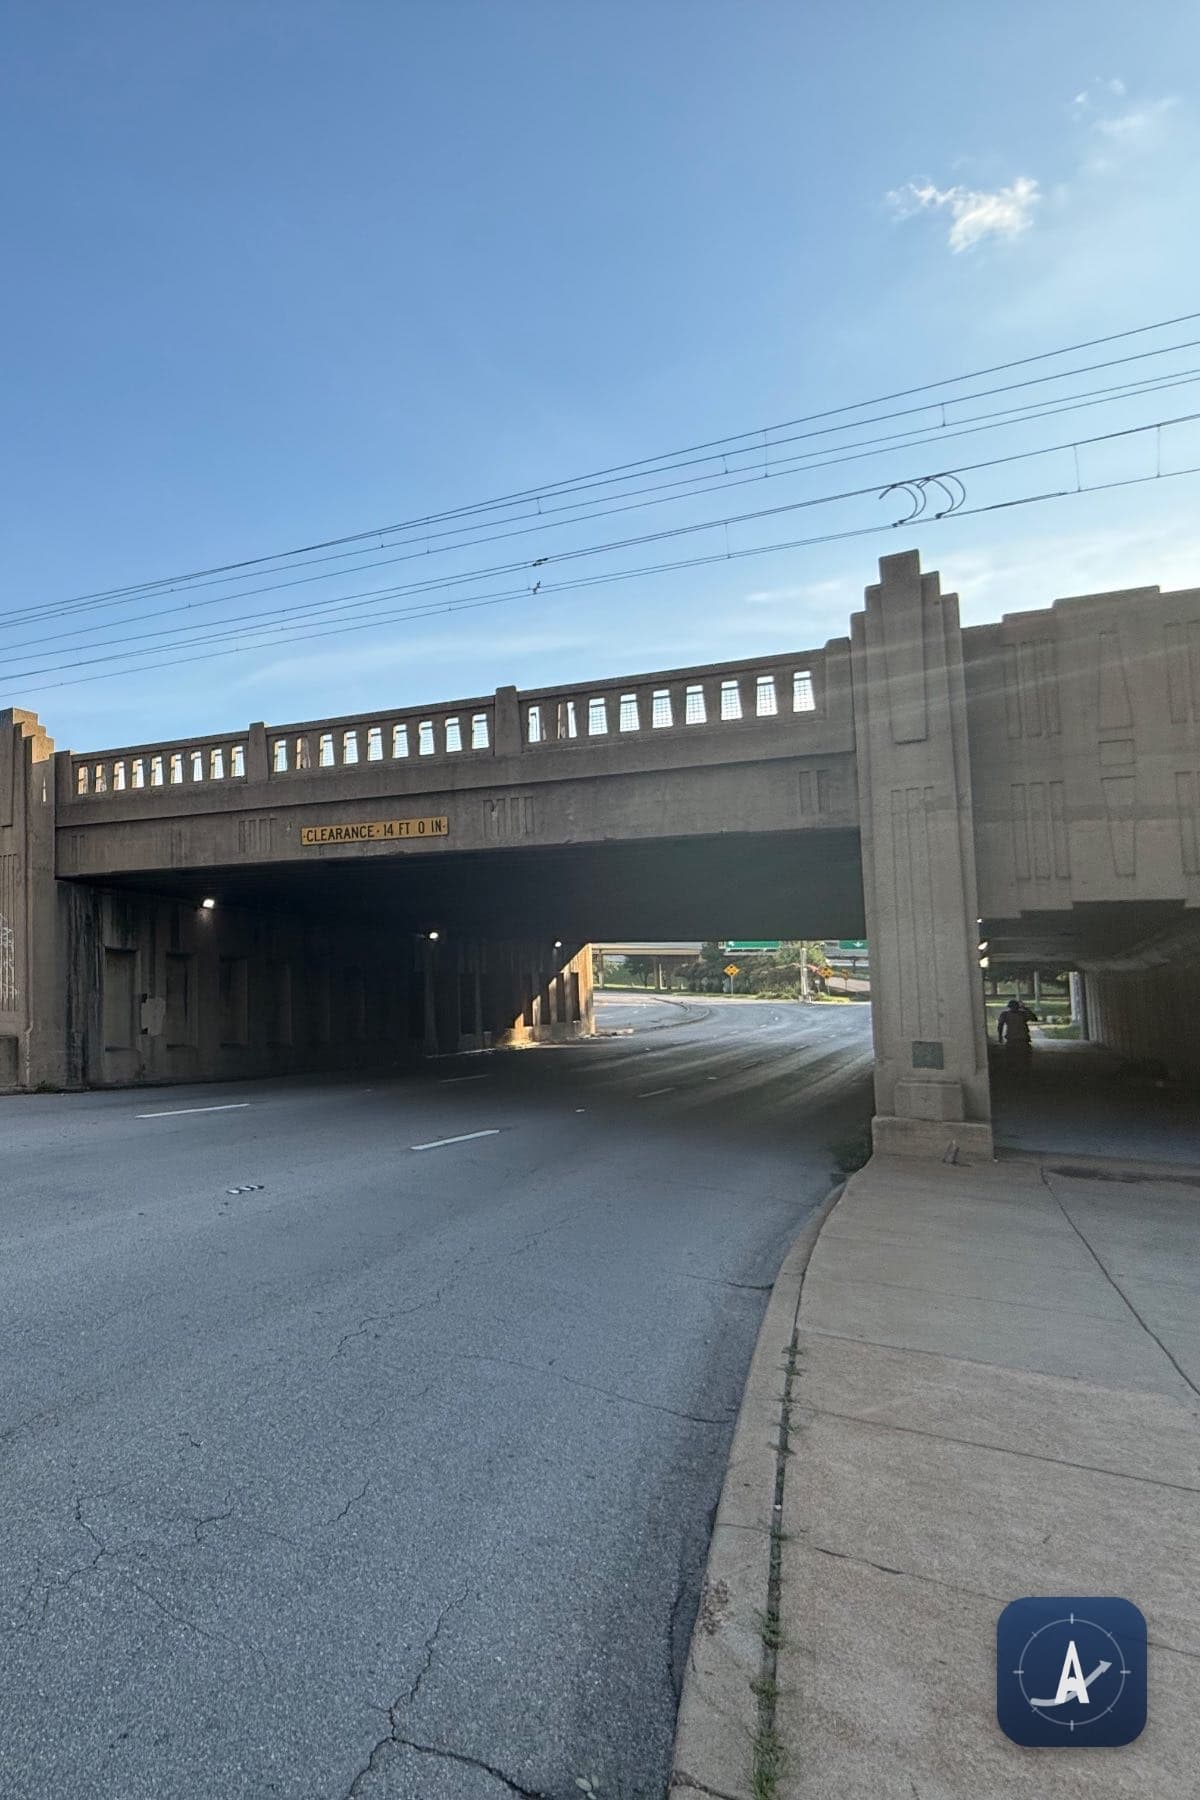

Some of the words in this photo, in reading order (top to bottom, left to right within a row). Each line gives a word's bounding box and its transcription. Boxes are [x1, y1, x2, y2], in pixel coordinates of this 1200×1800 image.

[306, 825, 375, 842] CLEARANCE
[383, 823, 393, 836] 14
[398, 821, 410, 835] FT
[431, 819, 442, 833] IN
